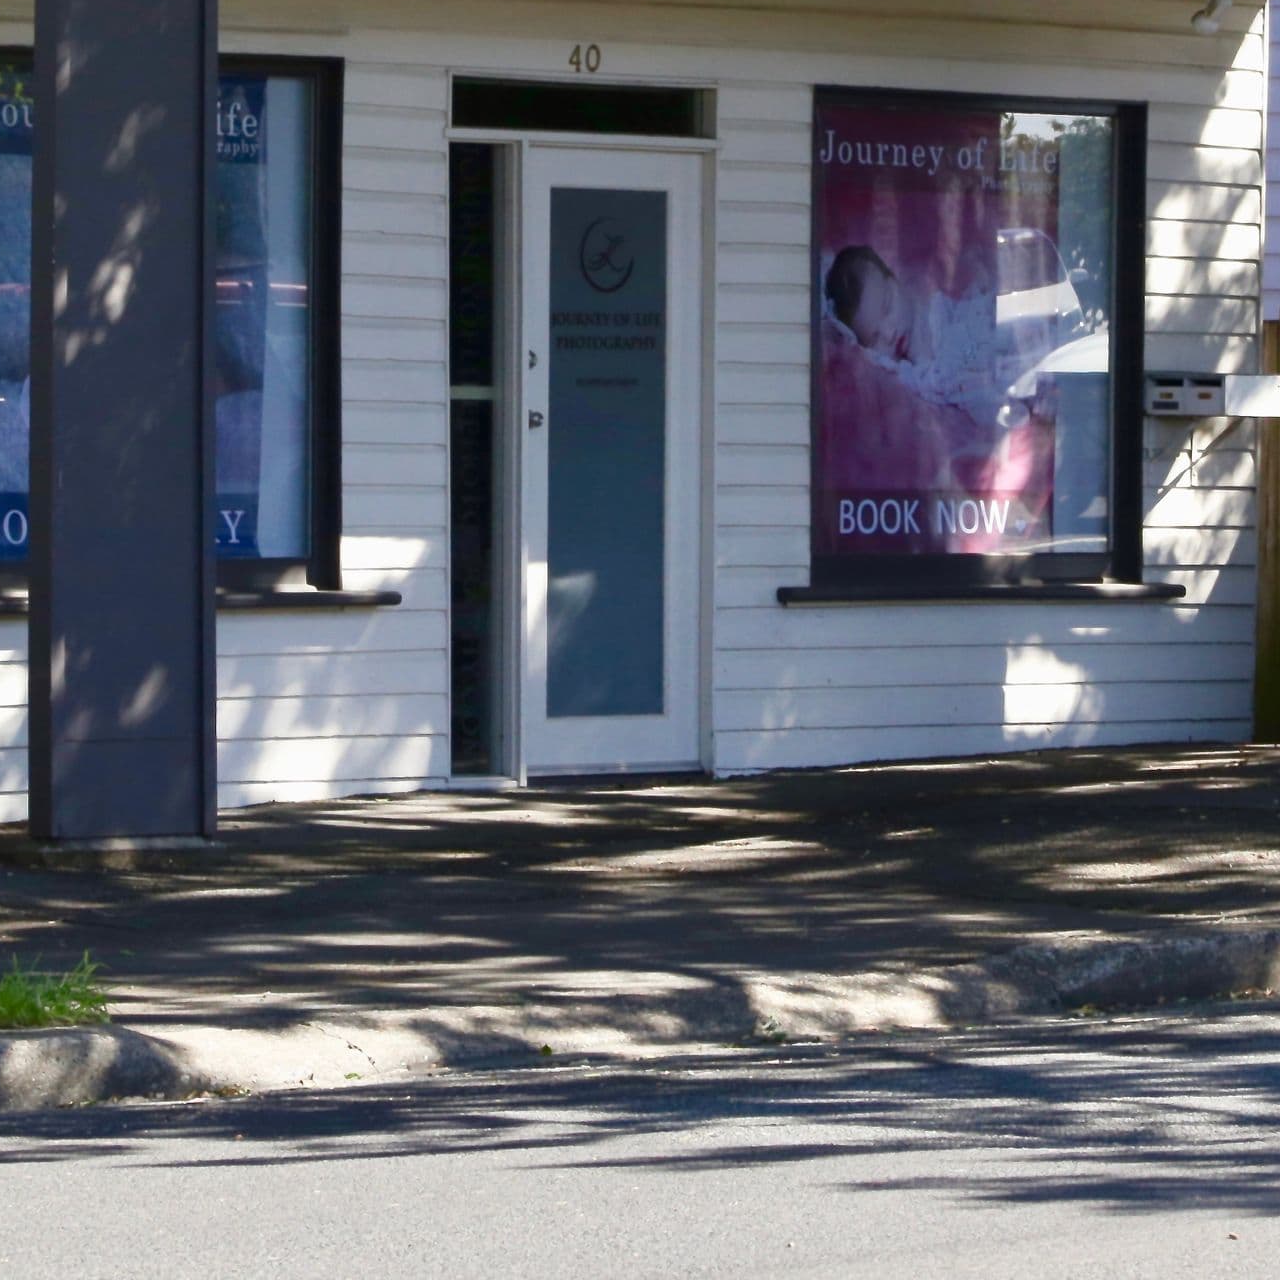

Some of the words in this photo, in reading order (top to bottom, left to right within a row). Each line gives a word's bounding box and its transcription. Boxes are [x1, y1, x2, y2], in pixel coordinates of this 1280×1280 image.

[568, 44, 601, 72] 40
[216, 100, 258, 137] ife
[820, 129, 944, 176] Journey
[957, 136, 988, 171] of
[998, 138, 1057, 173] Life
[838, 498, 920, 535] BOOK
[936, 499, 1011, 535] NOW
